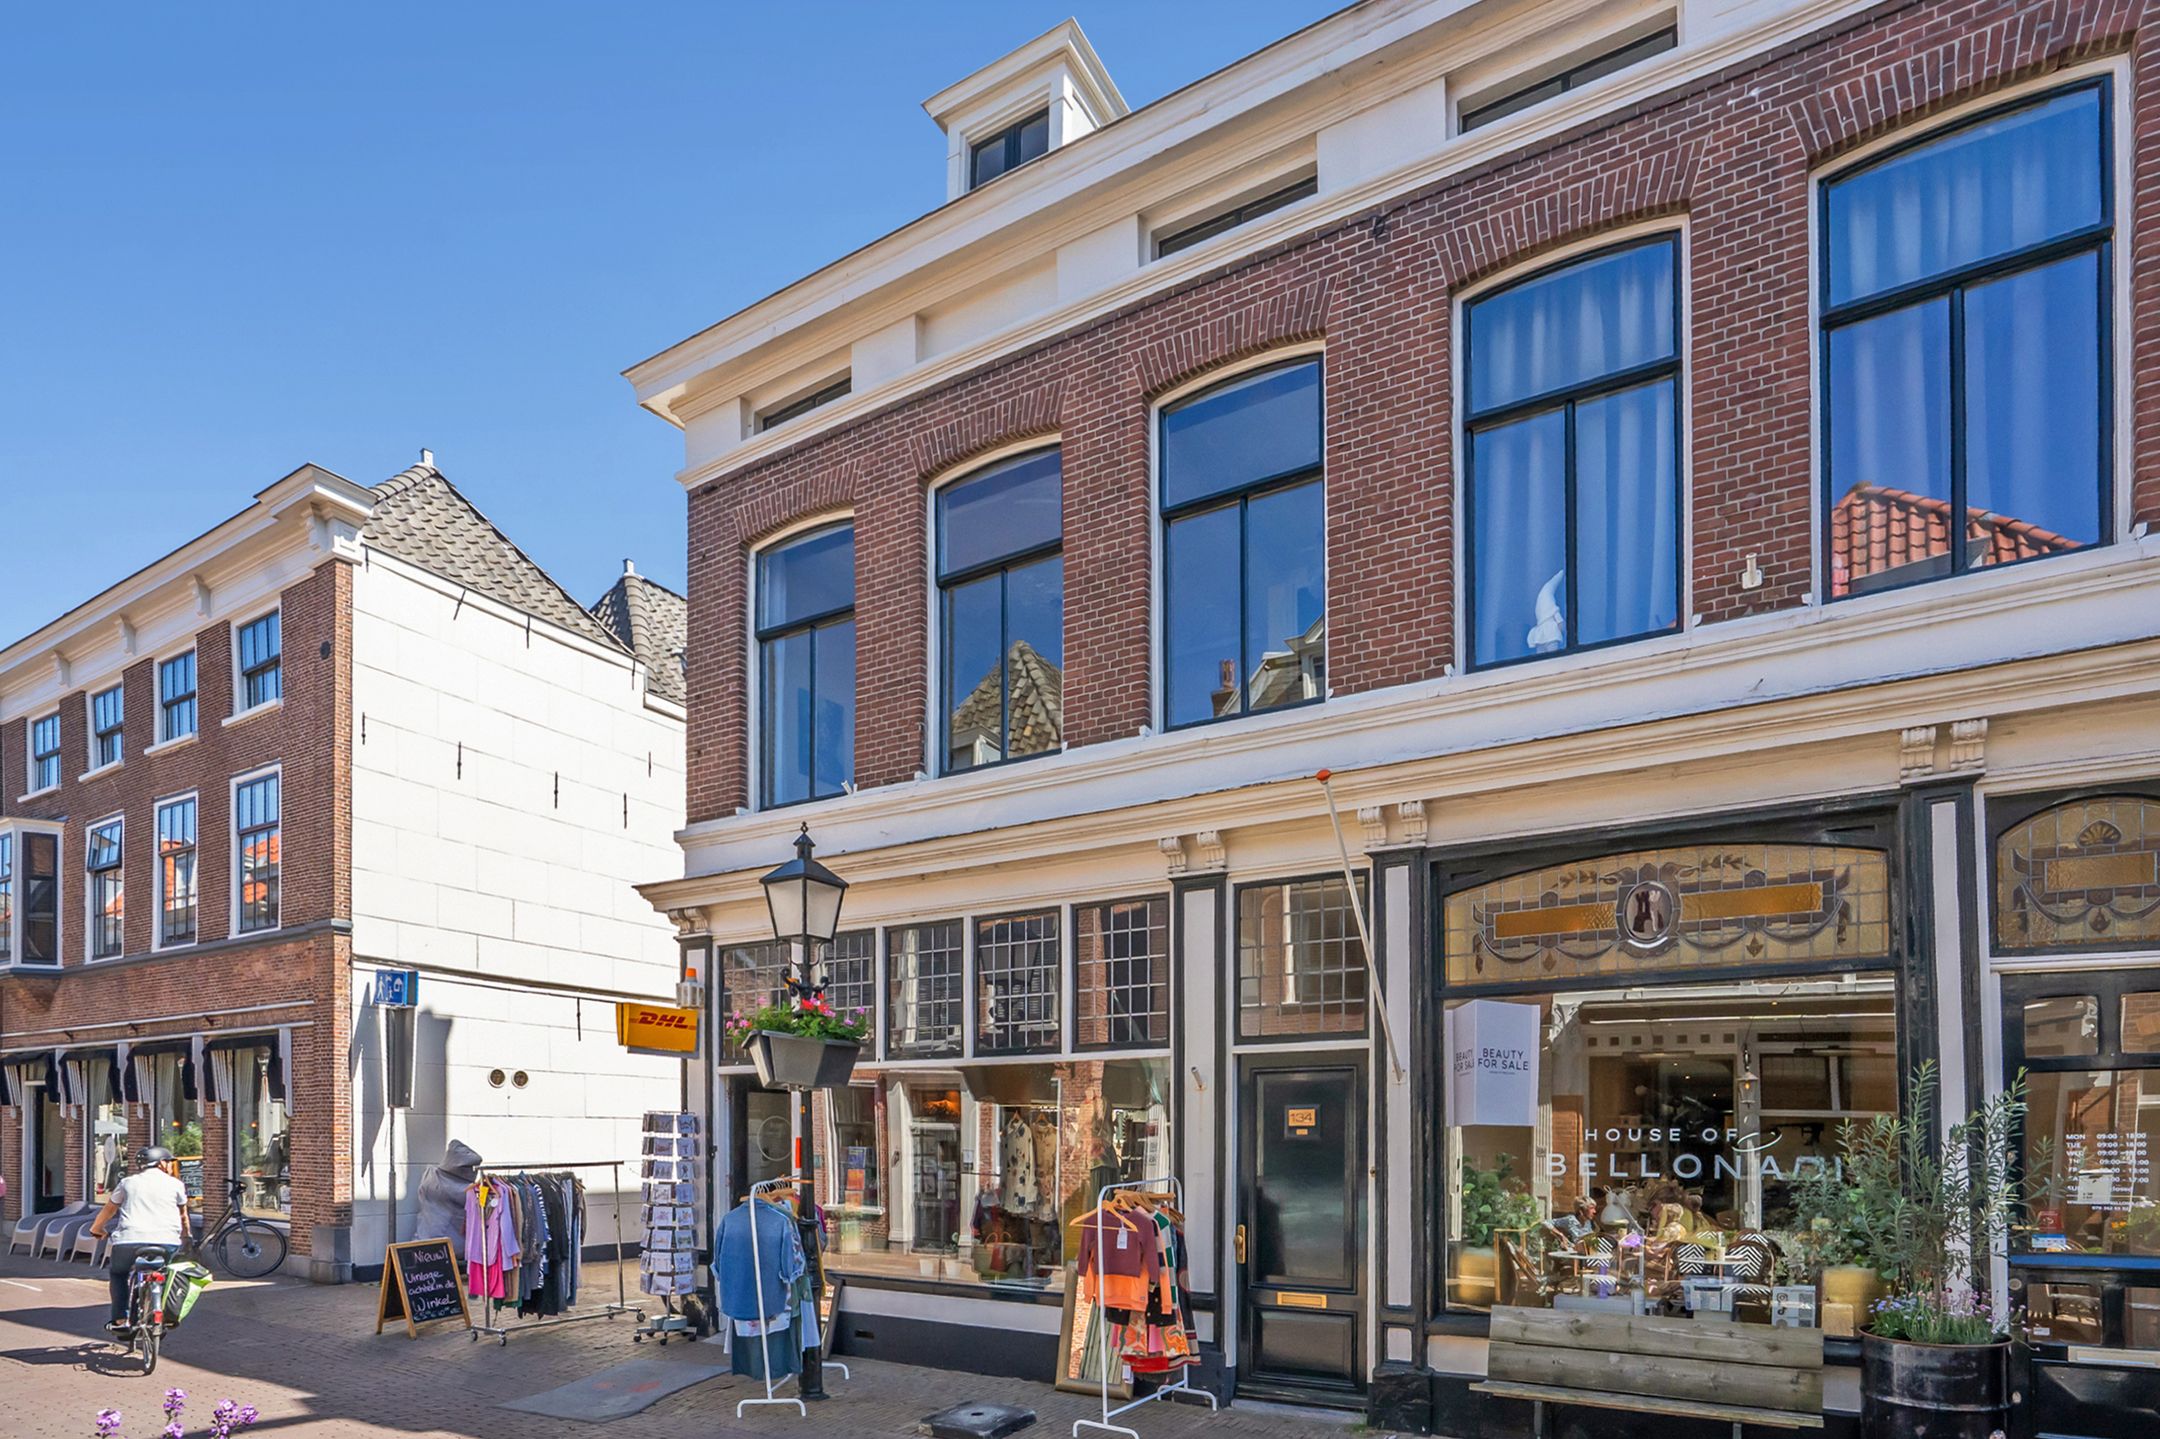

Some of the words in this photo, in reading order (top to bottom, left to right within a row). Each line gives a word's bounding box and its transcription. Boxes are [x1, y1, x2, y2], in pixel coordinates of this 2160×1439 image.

[638, 1011, 688, 1029] DHL
[1482, 1048, 1524, 1059] BEAUTY
[1477, 1058, 1497, 1068] FOR
[1502, 1060, 1529, 1071] SALE
[1290, 1112, 1312, 1123] 134
[1584, 1128, 1681, 1141] HOUSE
[1702, 1128, 1738, 1141] OF
[414, 1246, 449, 1264] Nieuw!
[405, 1271, 444, 1284] Vintage
[412, 1293, 457, 1312] Winkel
